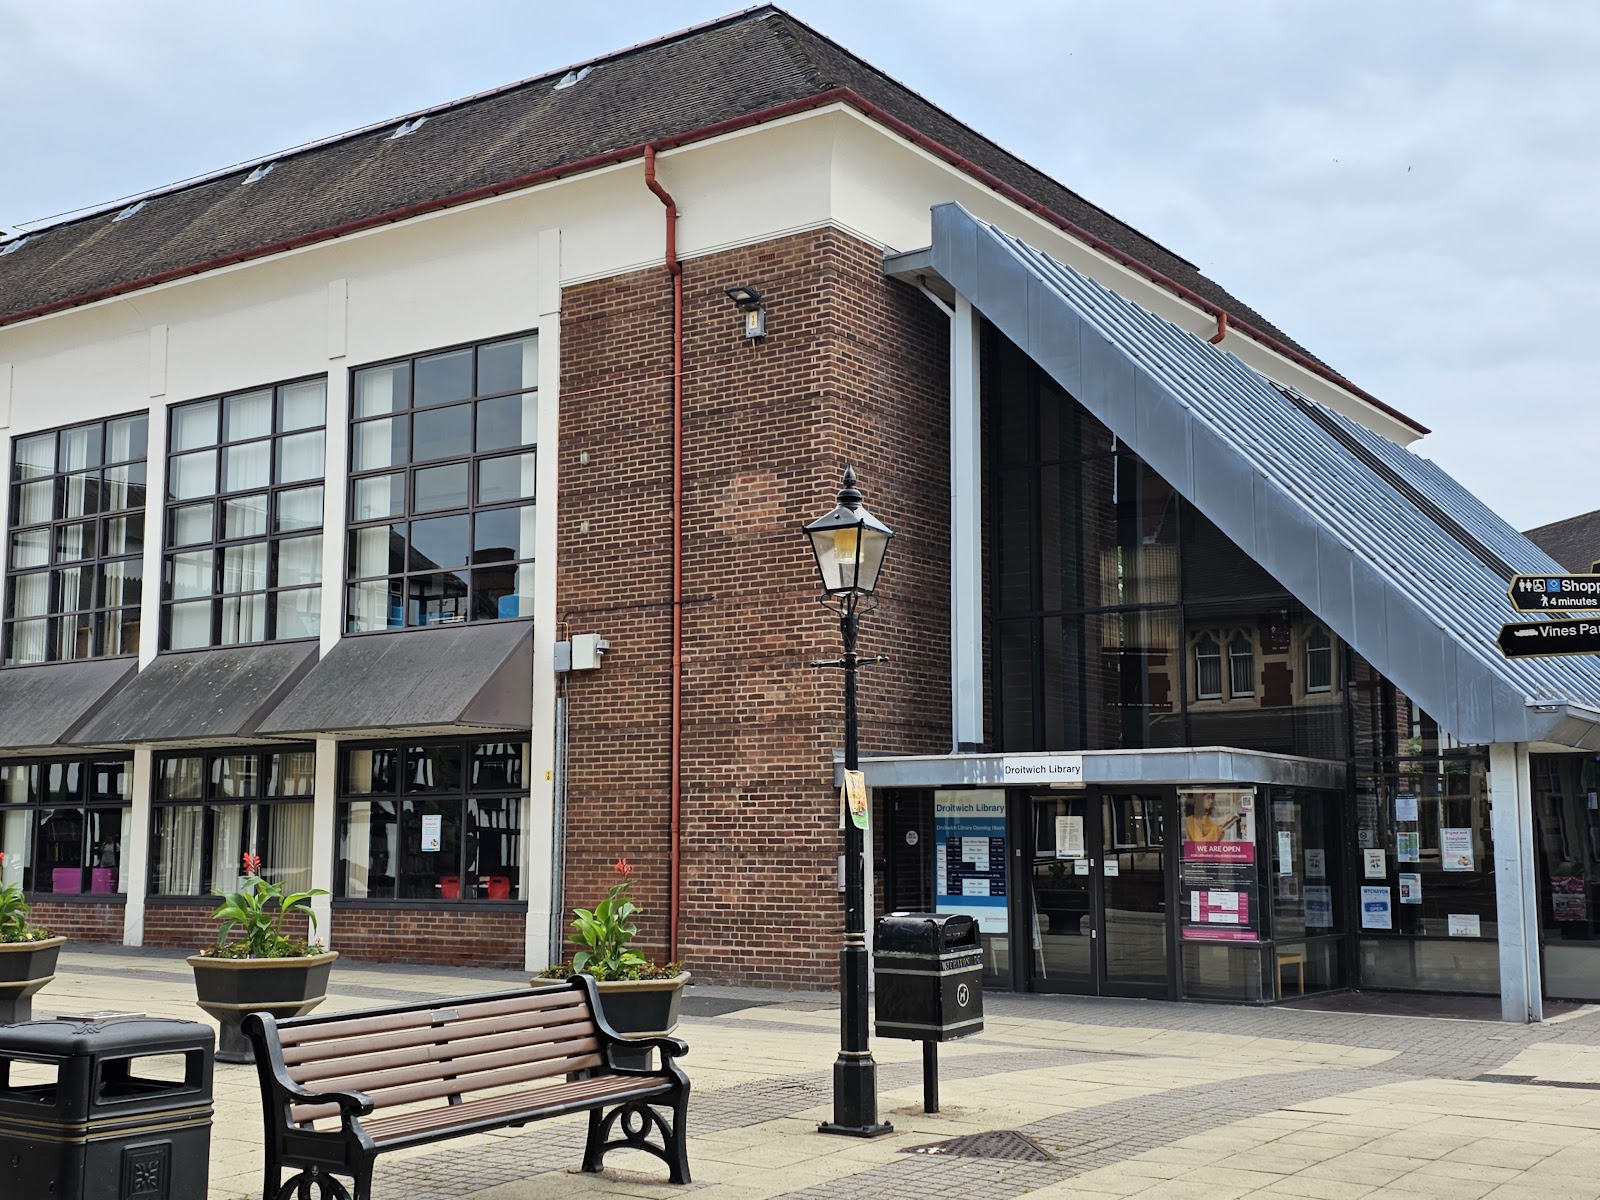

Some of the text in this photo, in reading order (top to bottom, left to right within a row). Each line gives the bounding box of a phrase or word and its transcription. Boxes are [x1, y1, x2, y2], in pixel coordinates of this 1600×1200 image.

[1550, 597, 1598, 605] 4 minutes
[1539, 623, 1600, 638] Vines Pa
[1005, 764, 1081, 775] Droitwich Library
[936, 803, 1005, 814] Droitwich Library
